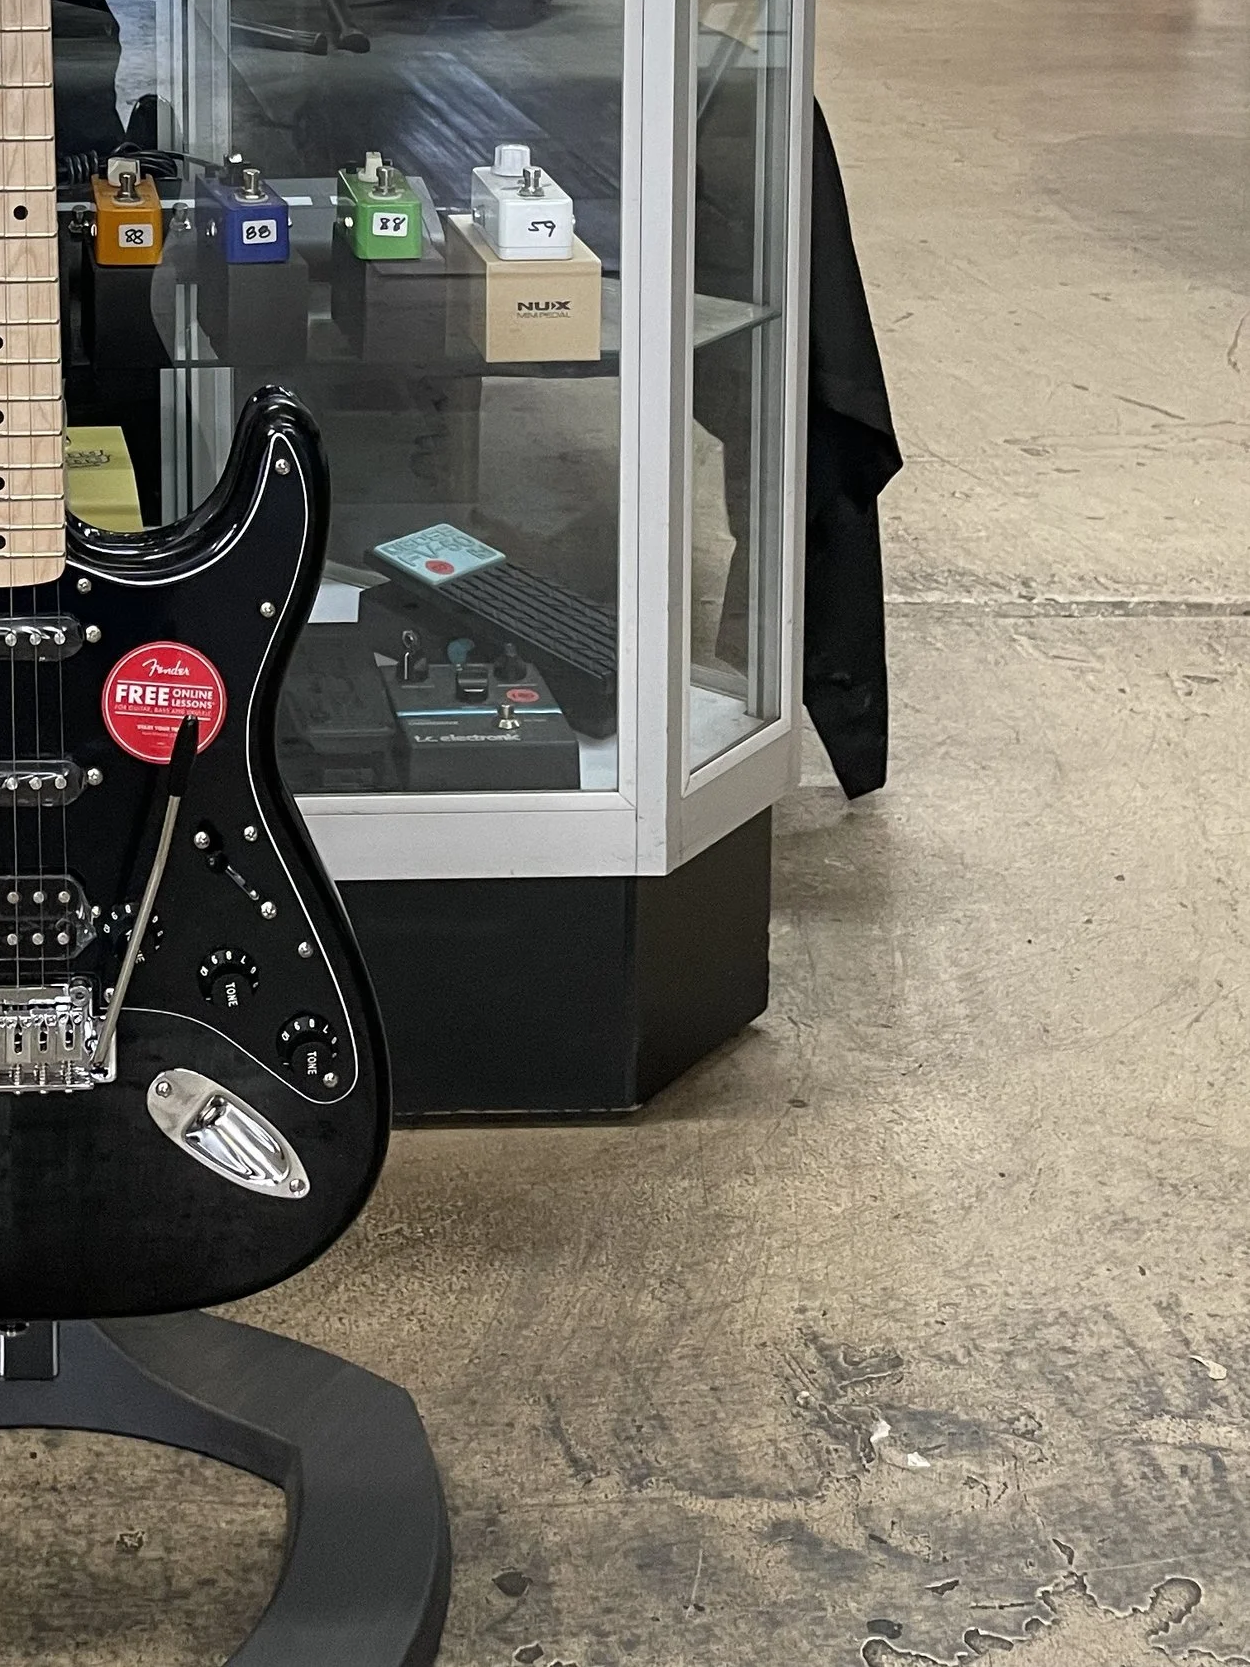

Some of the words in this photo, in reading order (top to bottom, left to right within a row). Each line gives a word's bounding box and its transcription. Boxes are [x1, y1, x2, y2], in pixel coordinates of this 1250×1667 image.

[517, 300, 571, 311] NUX
[142, 658, 190, 676] Fender
[115, 684, 170, 706] FREE
[172, 688, 213, 700] ONLINE
[440, 733, 522, 743] electronic
[225, 981, 239, 1008] TONE
[306, 1050, 318, 1076] TONE
